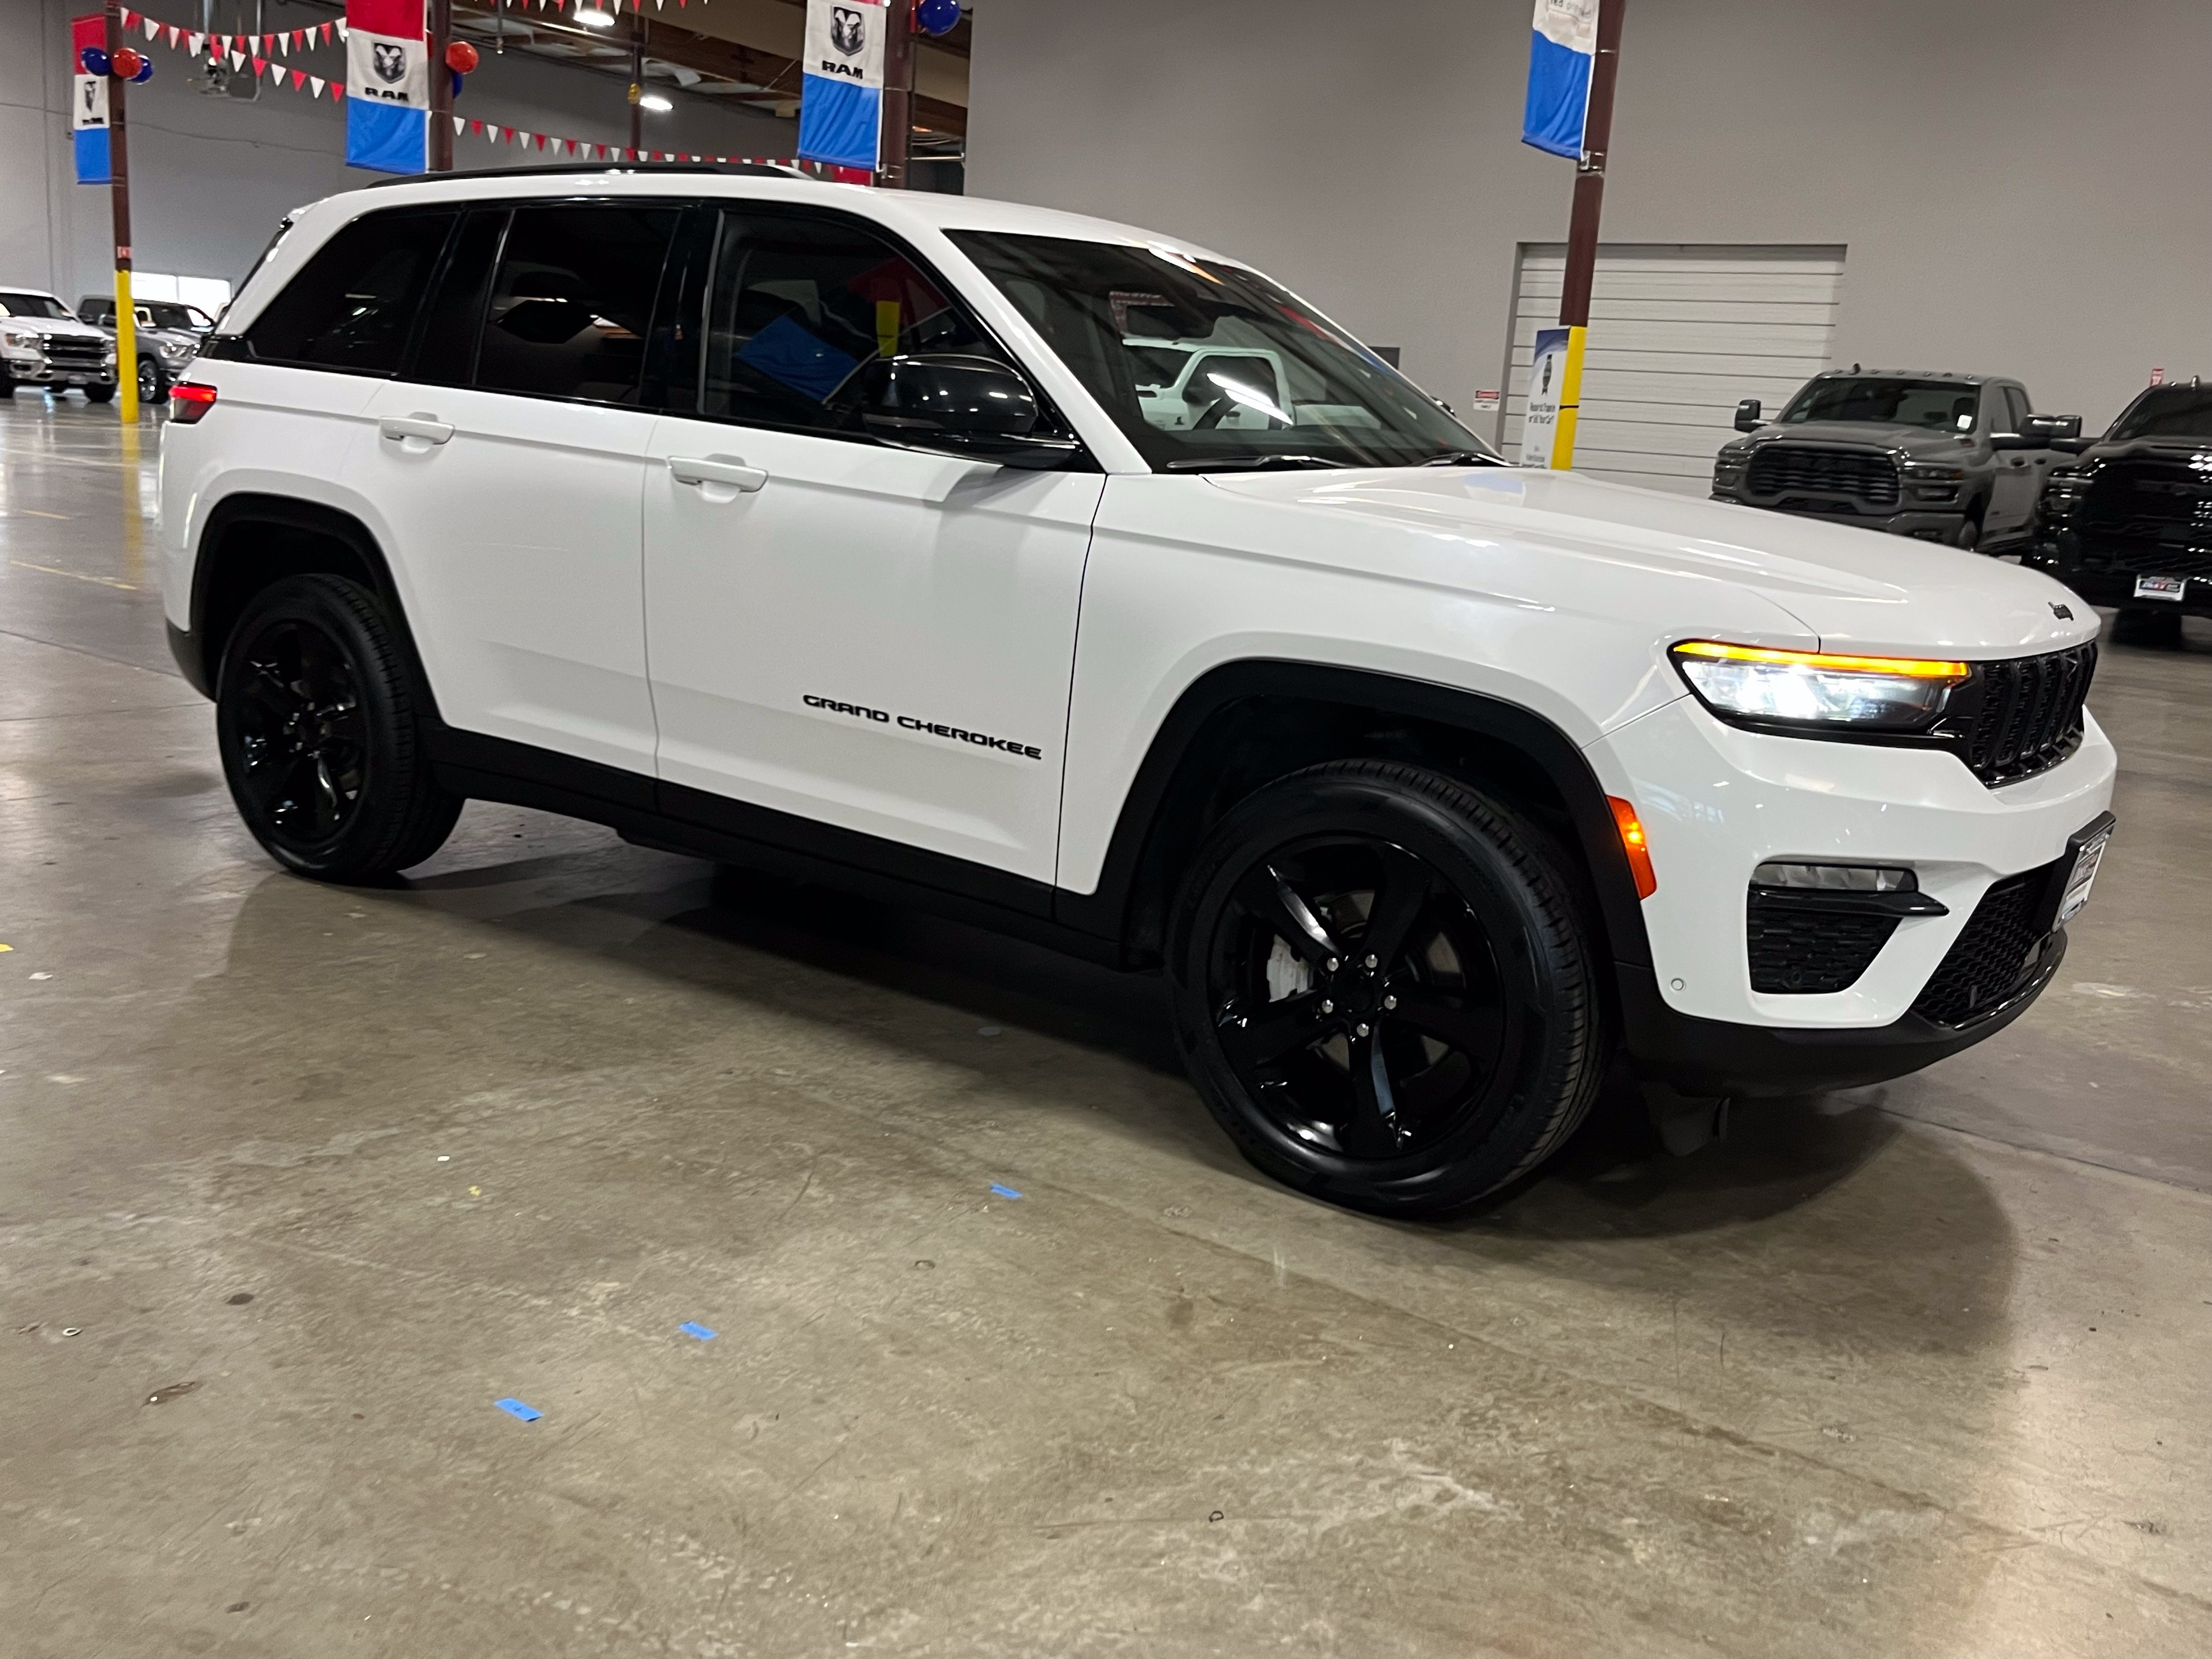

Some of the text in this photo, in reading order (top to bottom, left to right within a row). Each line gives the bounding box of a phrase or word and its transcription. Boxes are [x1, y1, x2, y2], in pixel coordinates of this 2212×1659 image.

[822, 60, 864, 80] RAM
[365, 87, 410, 103] RAM
[803, 695, 1042, 760] GRAND CHEROKEE
